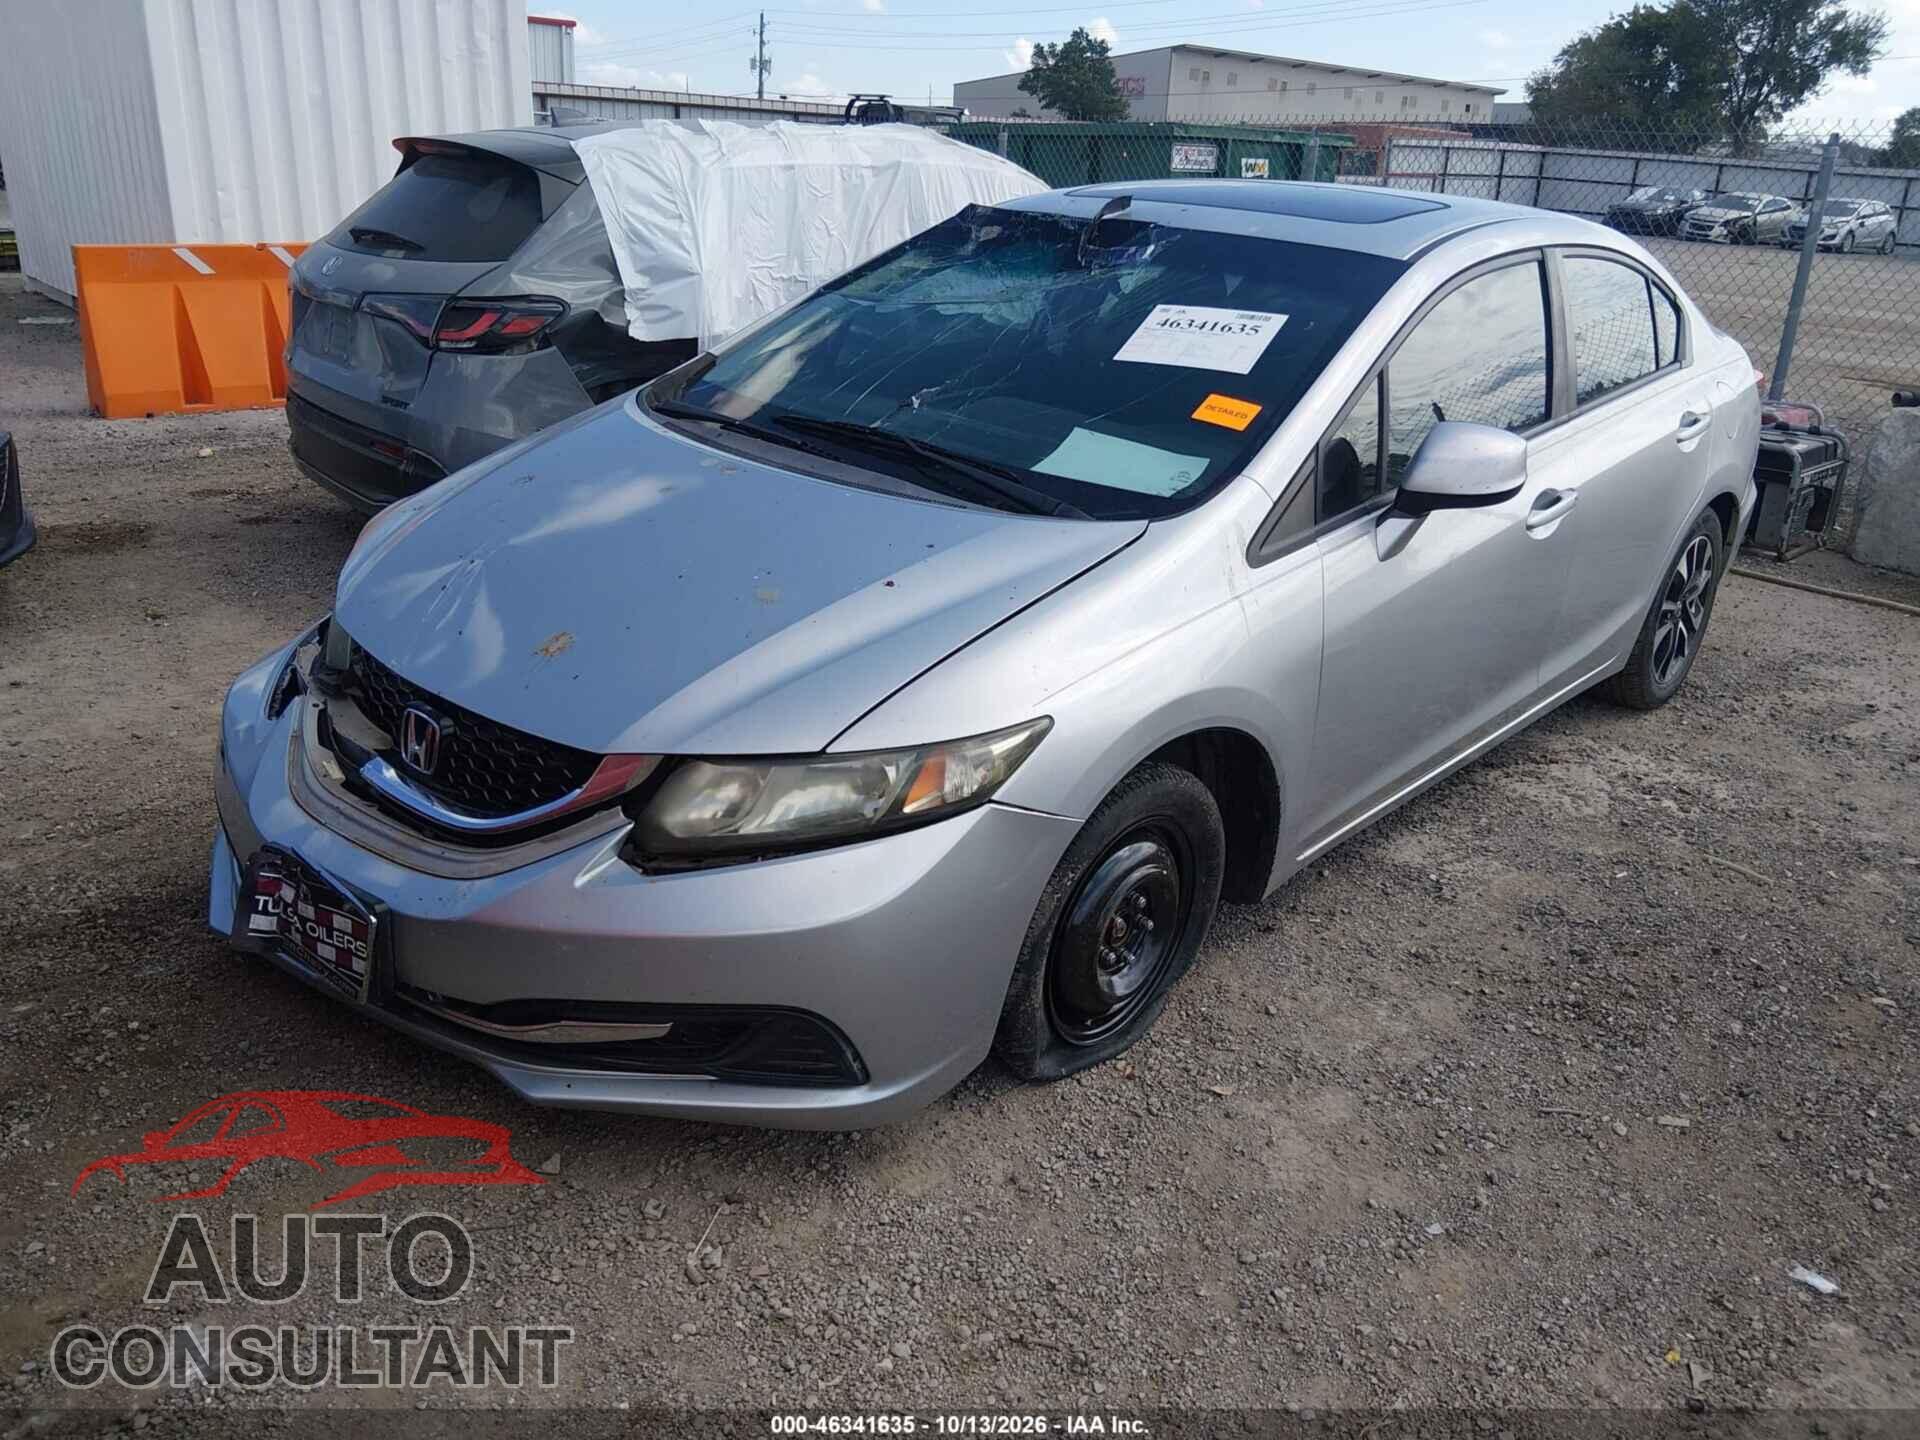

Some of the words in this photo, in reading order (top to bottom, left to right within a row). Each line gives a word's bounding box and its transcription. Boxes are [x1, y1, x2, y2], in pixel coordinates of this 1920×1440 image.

[1156, 317, 1262, 336] 46341635
[1204, 403, 1249, 420] DETAILED
[255, 895, 303, 931] TULSA
[306, 921, 367, 958] OILERS
